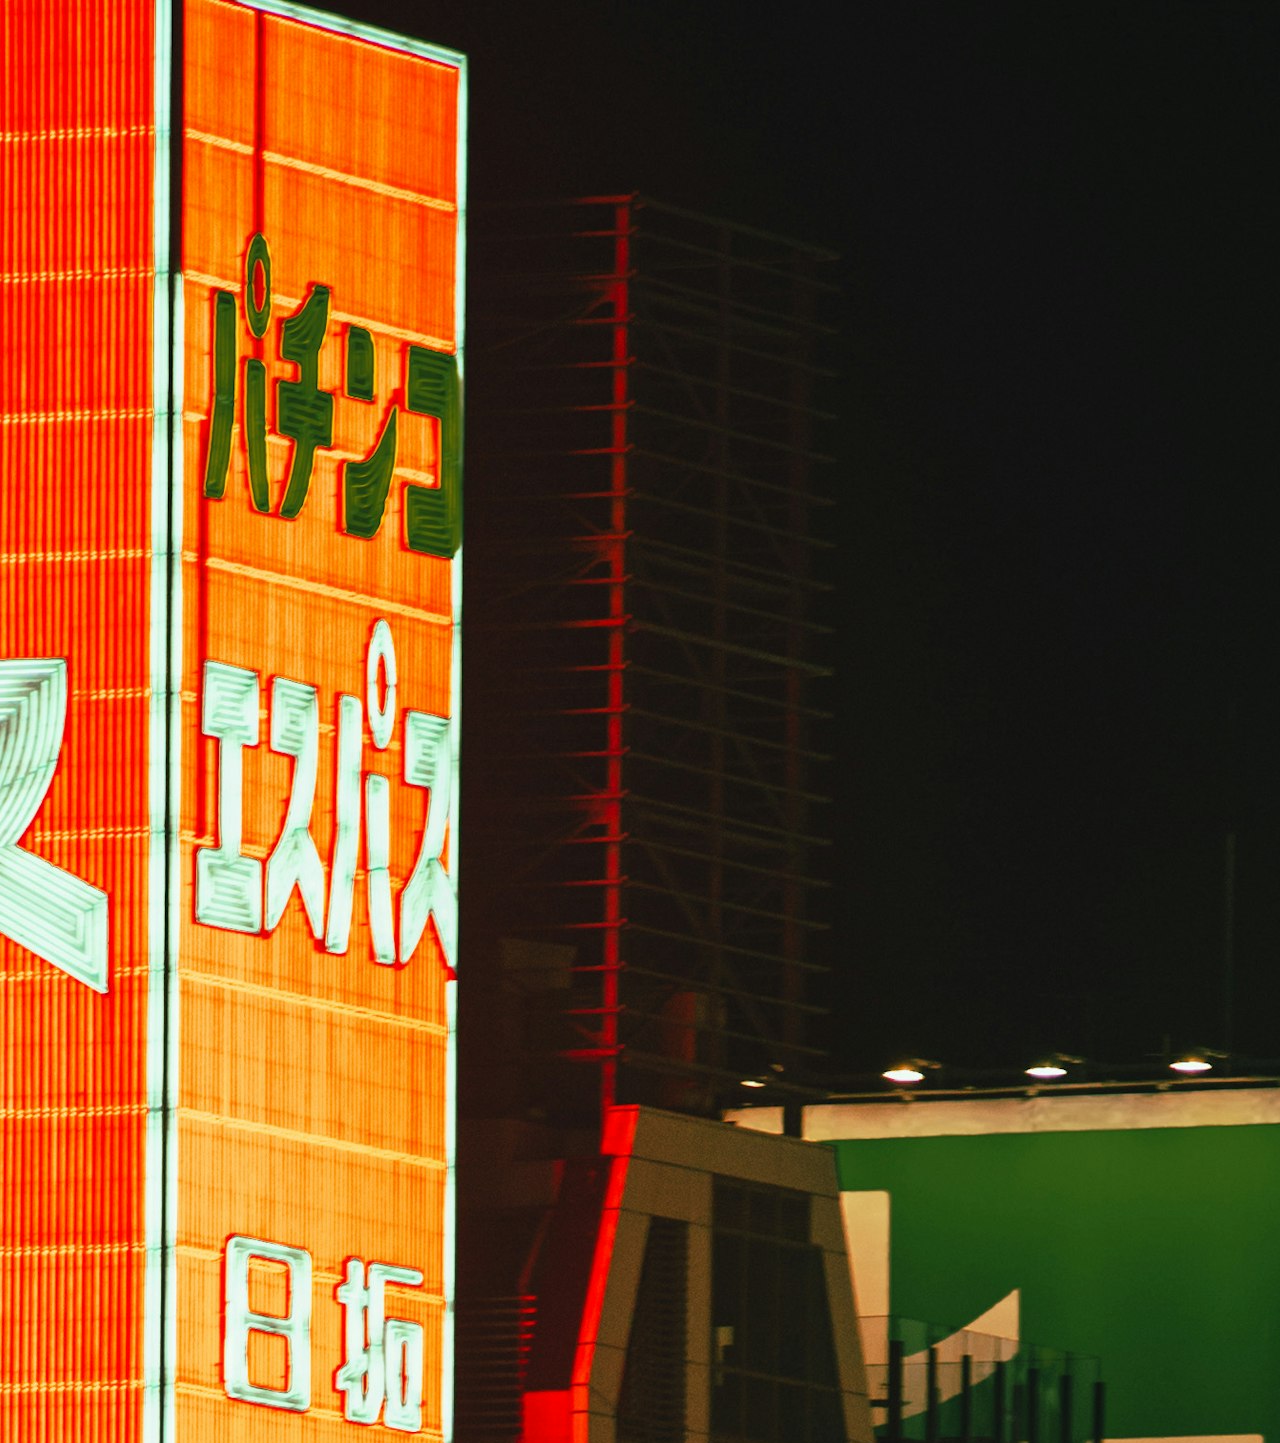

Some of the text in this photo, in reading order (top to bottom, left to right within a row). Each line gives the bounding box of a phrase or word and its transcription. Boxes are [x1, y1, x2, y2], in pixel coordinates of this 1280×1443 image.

[203, 233, 464, 558] パチンコ
[193, 620, 457, 968] エスパス
[224, 1236, 426, 1432] 日拓
